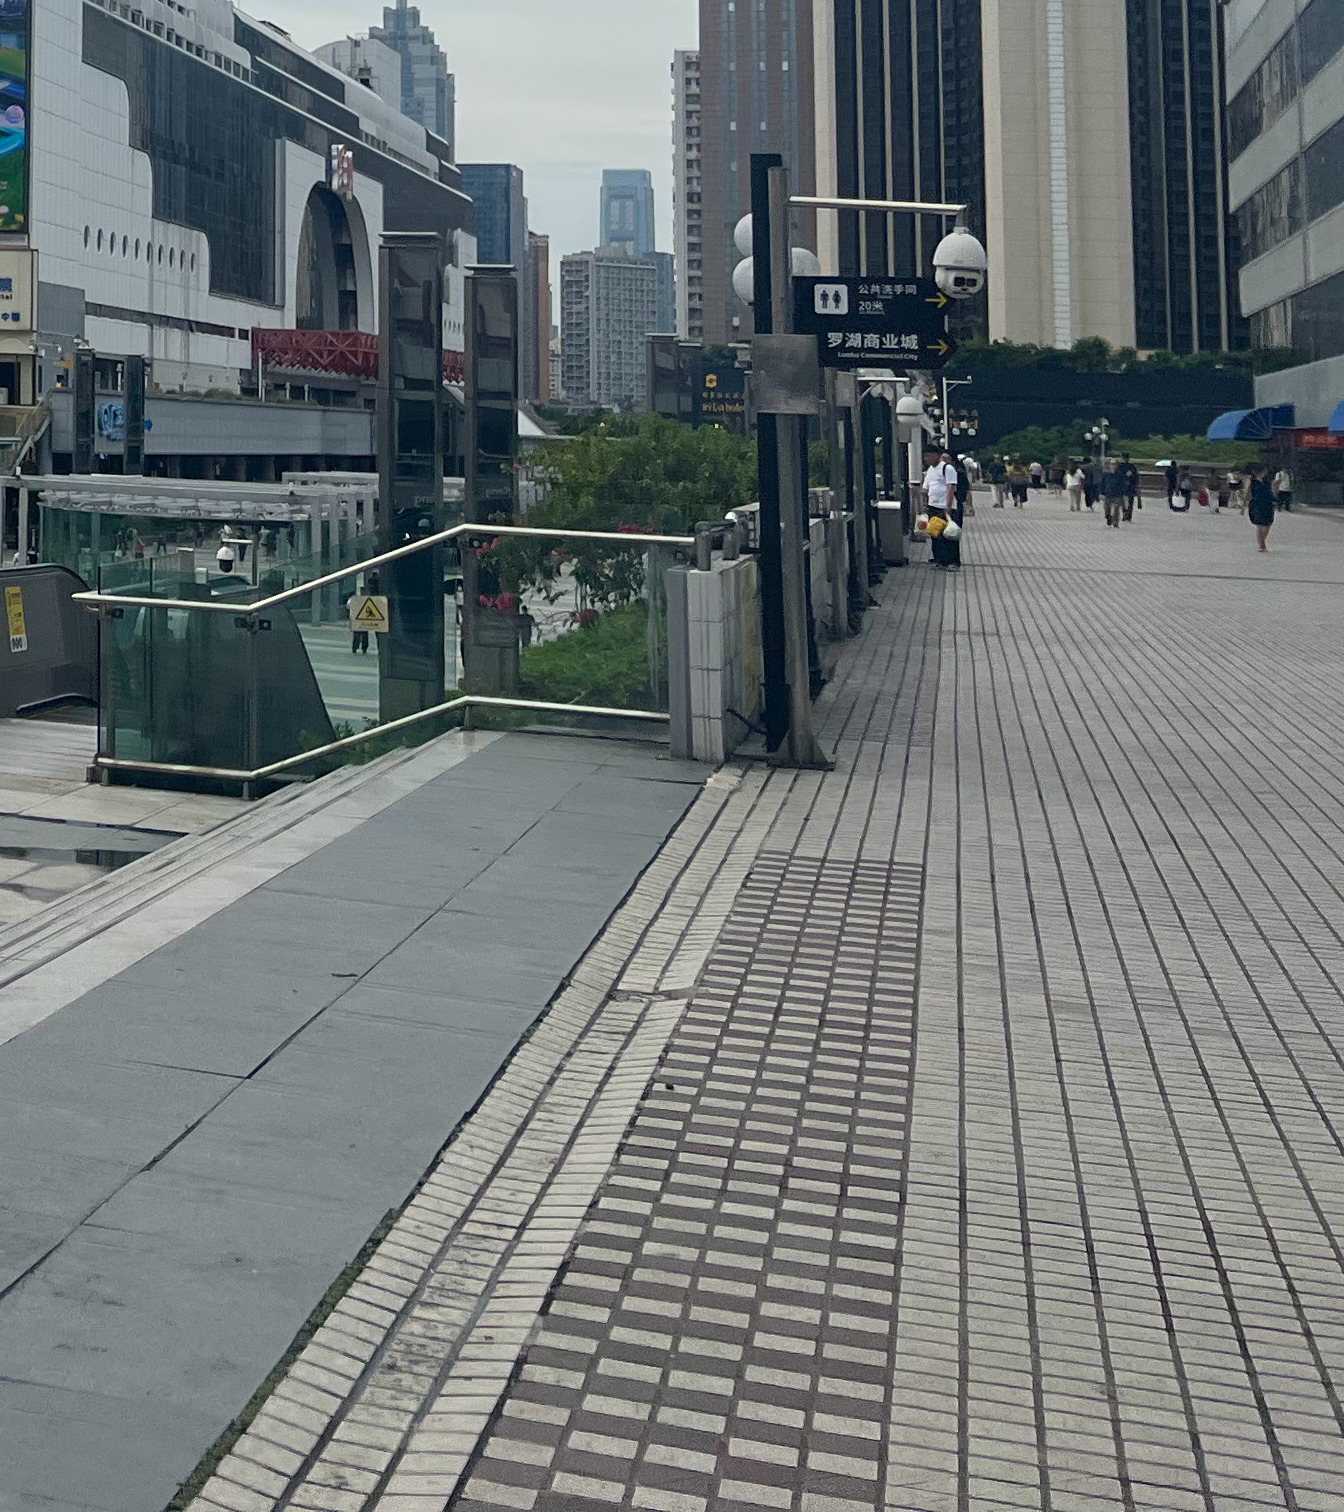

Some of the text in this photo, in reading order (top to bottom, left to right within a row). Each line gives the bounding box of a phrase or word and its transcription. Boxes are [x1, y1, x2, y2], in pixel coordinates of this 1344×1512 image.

[858, 301, 883, 311] 20米
[827, 332, 919, 350] 罗湖商业城
